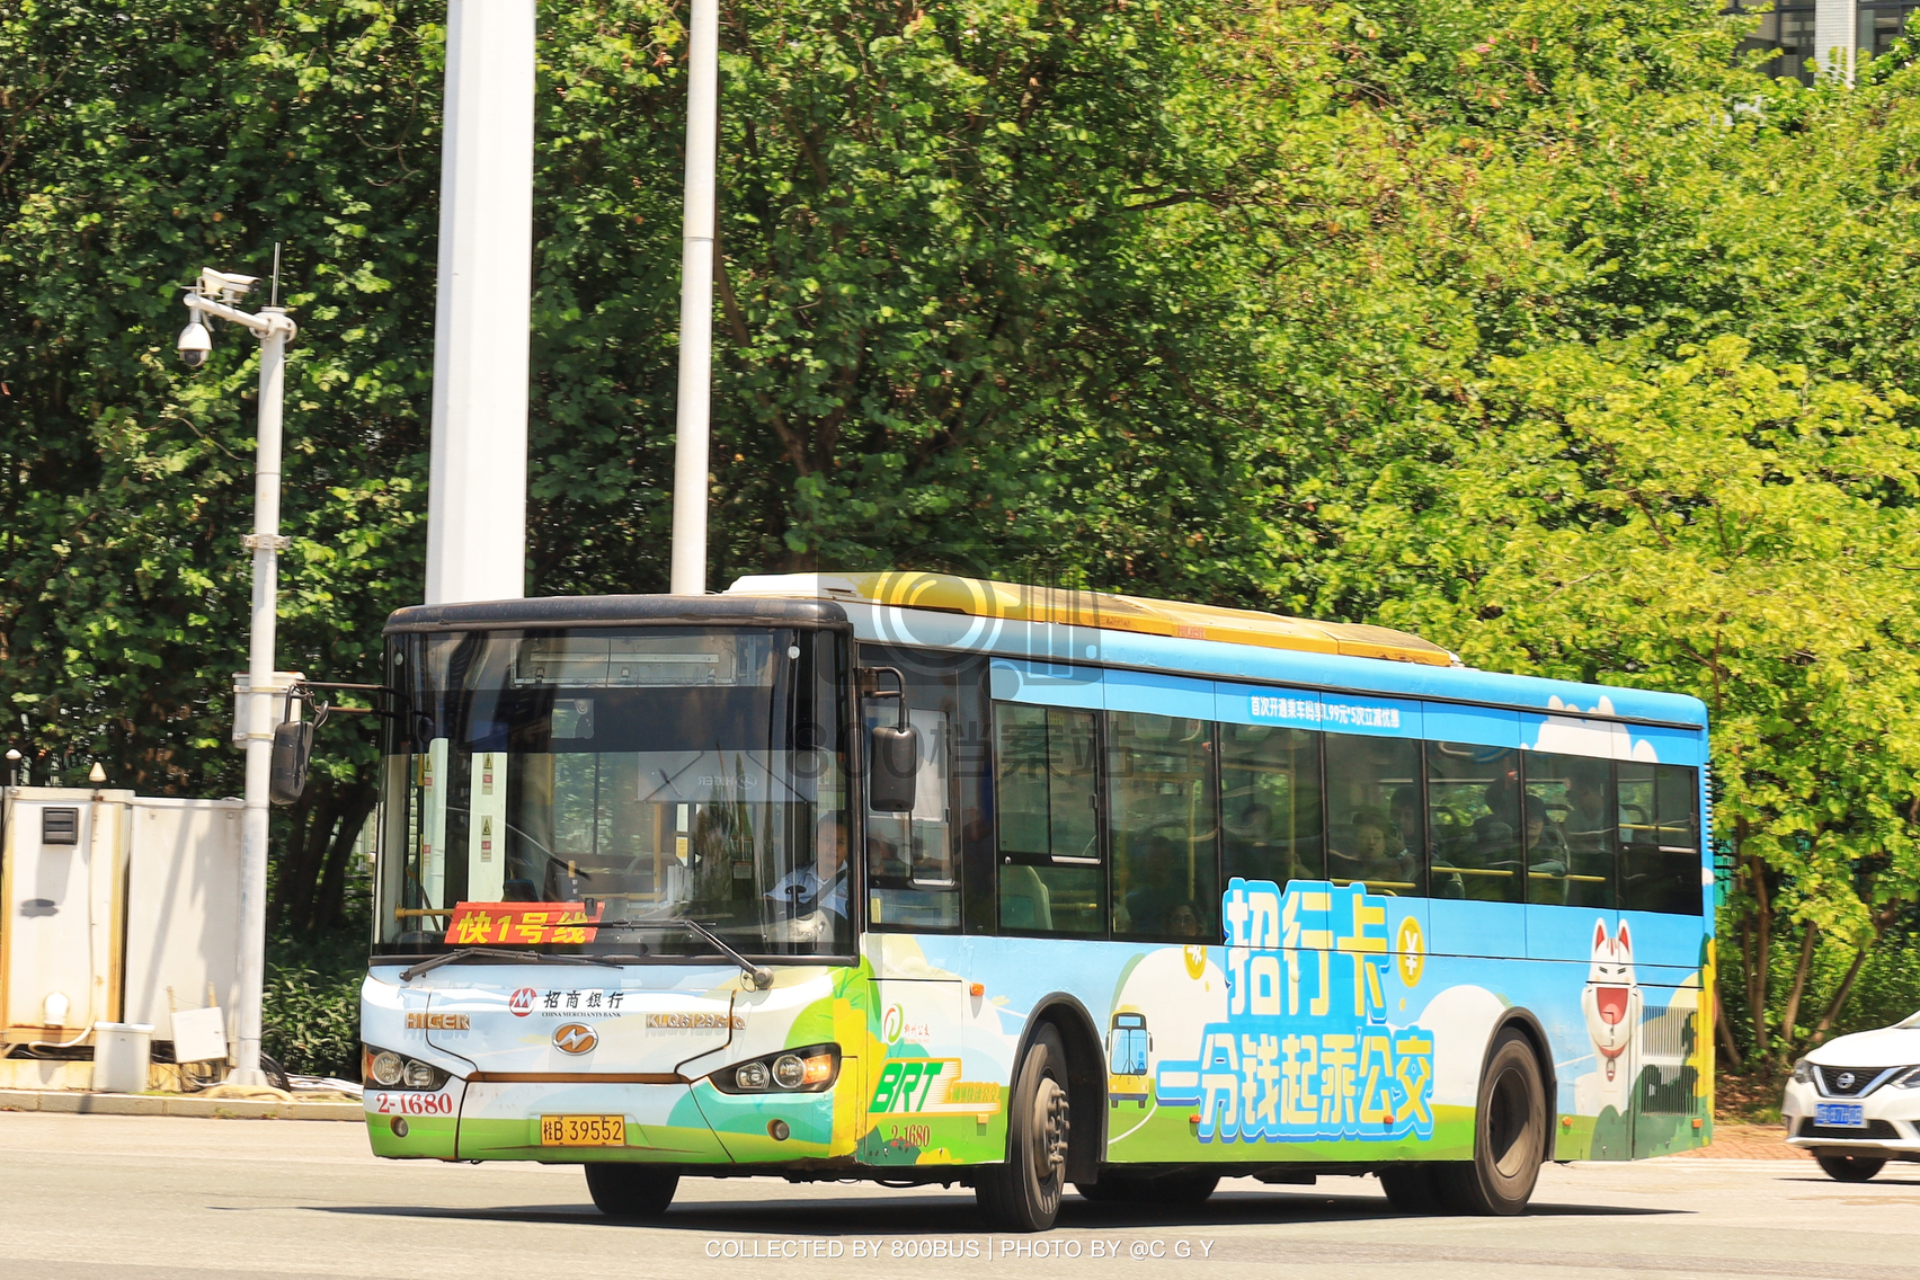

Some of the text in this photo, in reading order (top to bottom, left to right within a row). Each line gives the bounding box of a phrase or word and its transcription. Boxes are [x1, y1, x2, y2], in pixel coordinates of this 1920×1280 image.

[456, 911, 589, 944] 快1号线
[1227, 888, 1388, 1017] 招行卡
[543, 989, 624, 1010] 招商银行
[405, 1013, 471, 1031] HIGER
[867, 1062, 944, 1113] BRT
[1160, 1031, 1432, 1125] 一分钱起乘公交
[376, 1092, 453, 1115] 2-1680
[890, 1124, 930, 1149] 2-1680
